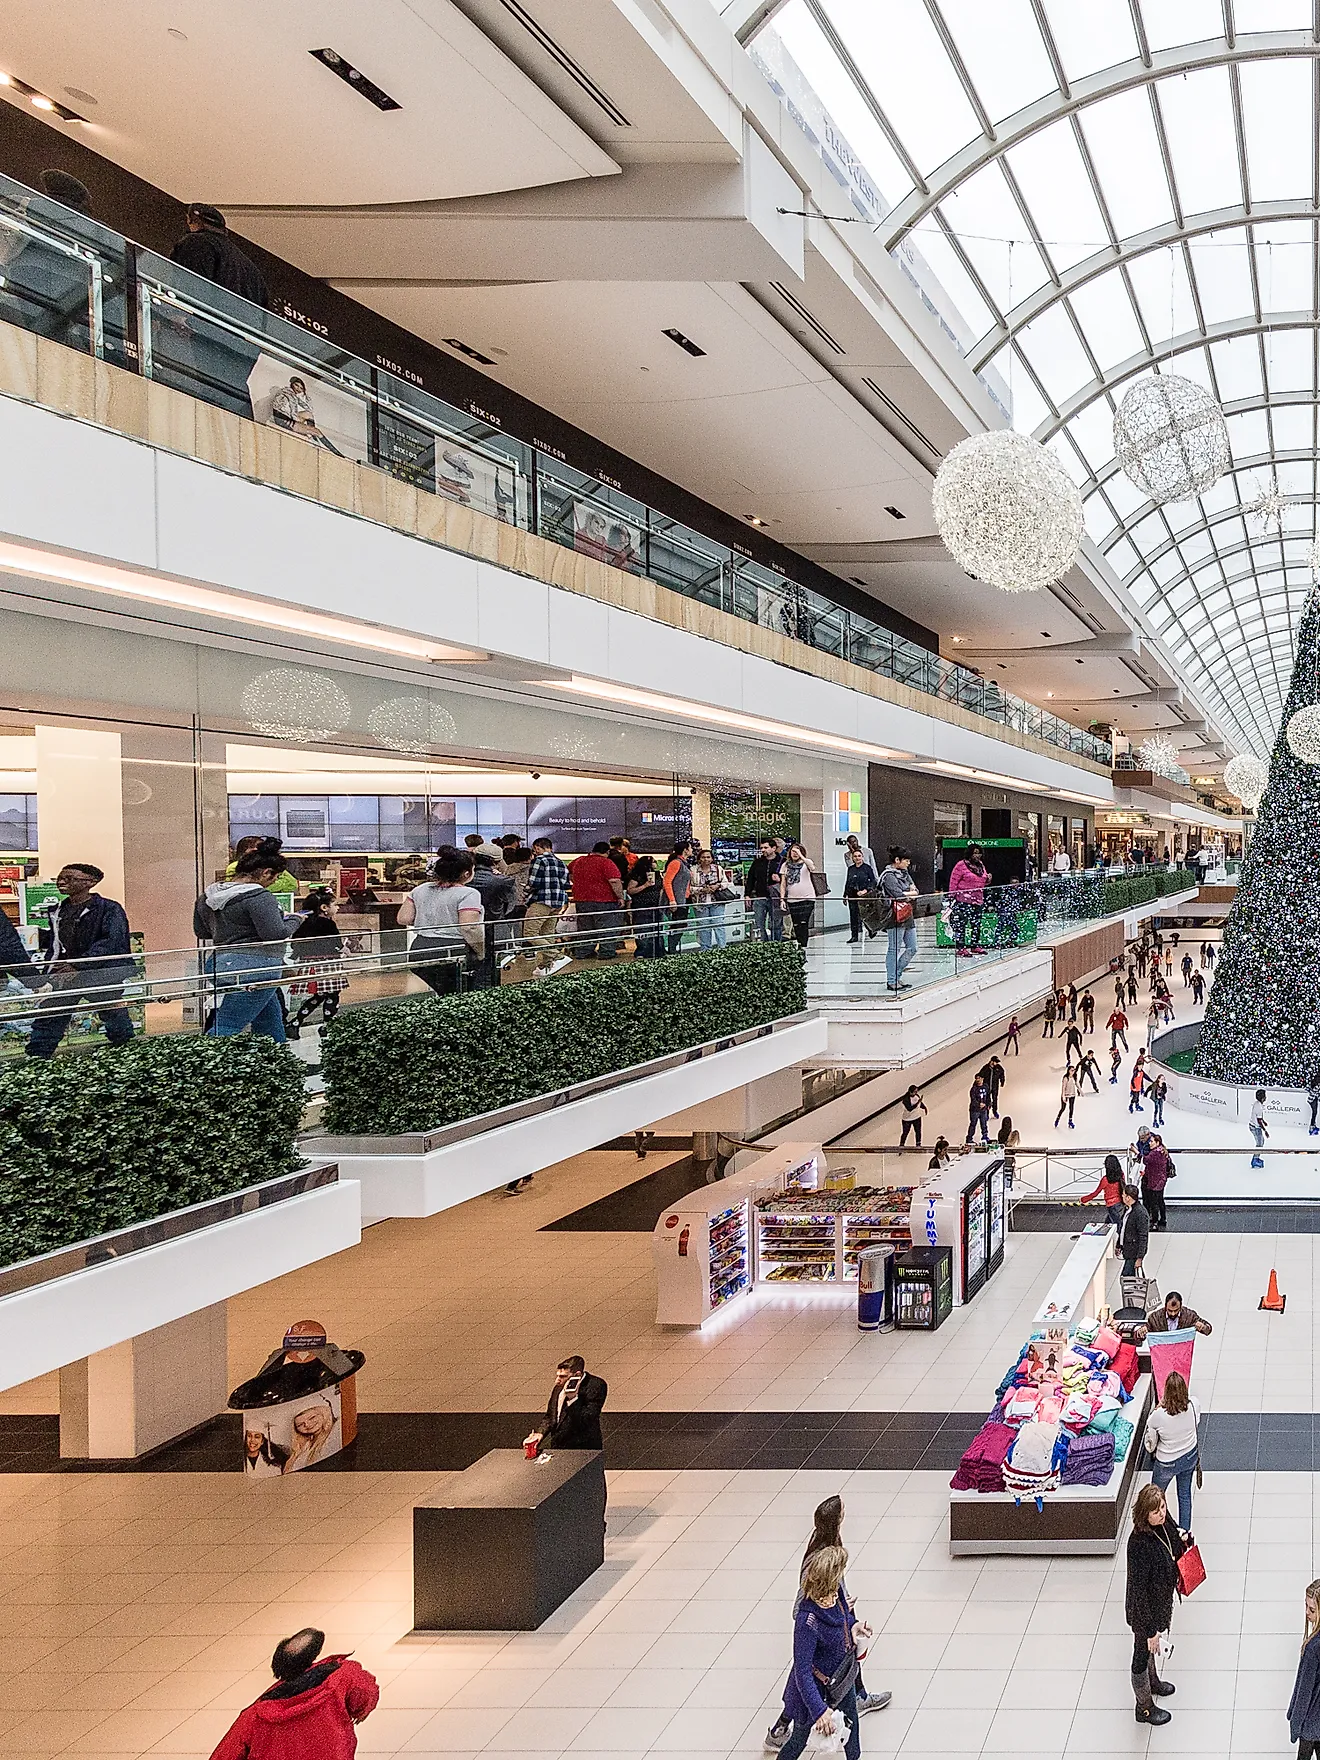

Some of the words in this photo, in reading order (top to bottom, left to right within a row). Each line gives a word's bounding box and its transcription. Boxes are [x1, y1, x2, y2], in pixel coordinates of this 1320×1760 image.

[283, 306, 329, 337] SIX:02
[376, 354, 424, 386] SIX02.COM
[469, 404, 501, 425] SIX:02
[393, 444, 418, 460] SIX:02
[532, 437, 566, 460] SIX02.COM
[598, 472, 621, 489] SIX:02
[745, 811, 787, 825] magic
[1200, 1095, 1227, 1106] GALLERIA
[1266, 1105, 1301, 1113] GALLERIA
[925, 1199, 938, 1247] YUMMY
[859, 1280, 873, 1290] Bull
